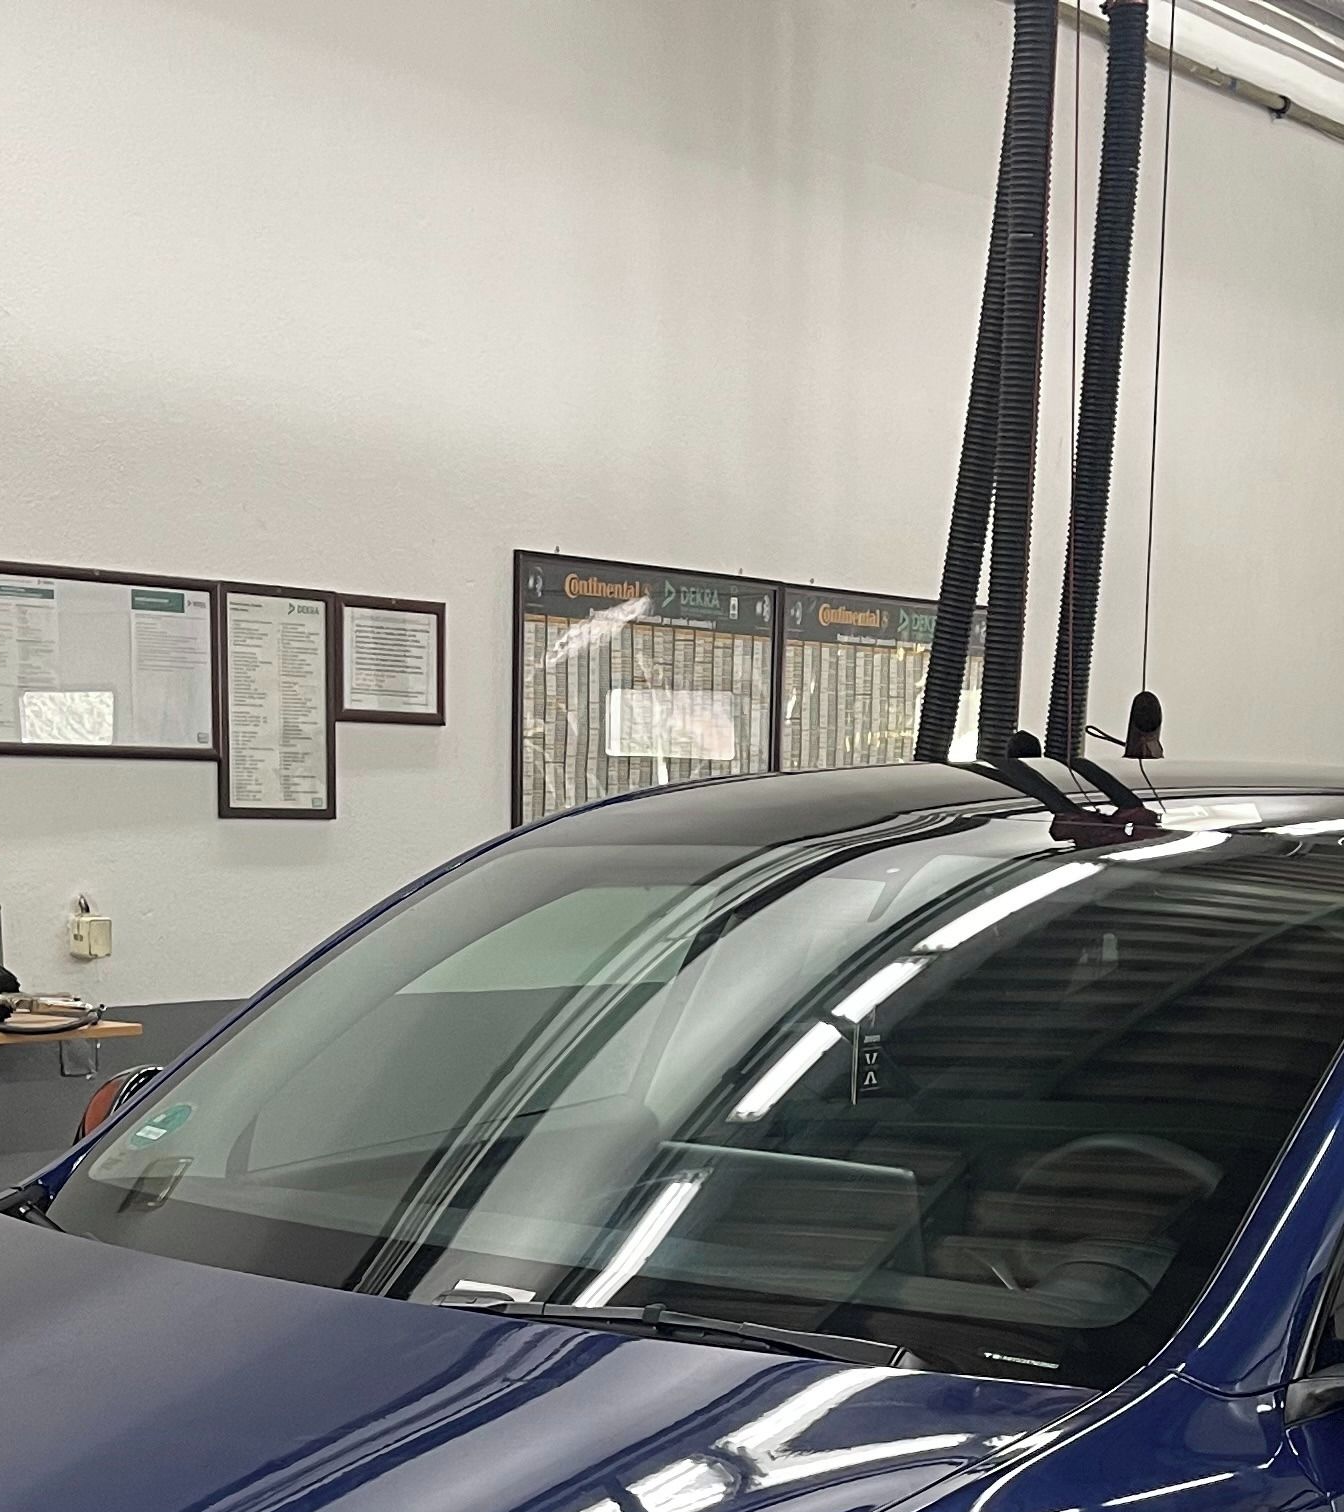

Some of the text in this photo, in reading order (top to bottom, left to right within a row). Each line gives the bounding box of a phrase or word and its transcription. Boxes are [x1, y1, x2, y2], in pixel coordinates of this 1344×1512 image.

[564, 572, 641, 600] Continental
[680, 586, 721, 609] DEKRA
[818, 602, 881, 628] Continental
[912, 613, 937, 631] DEK
